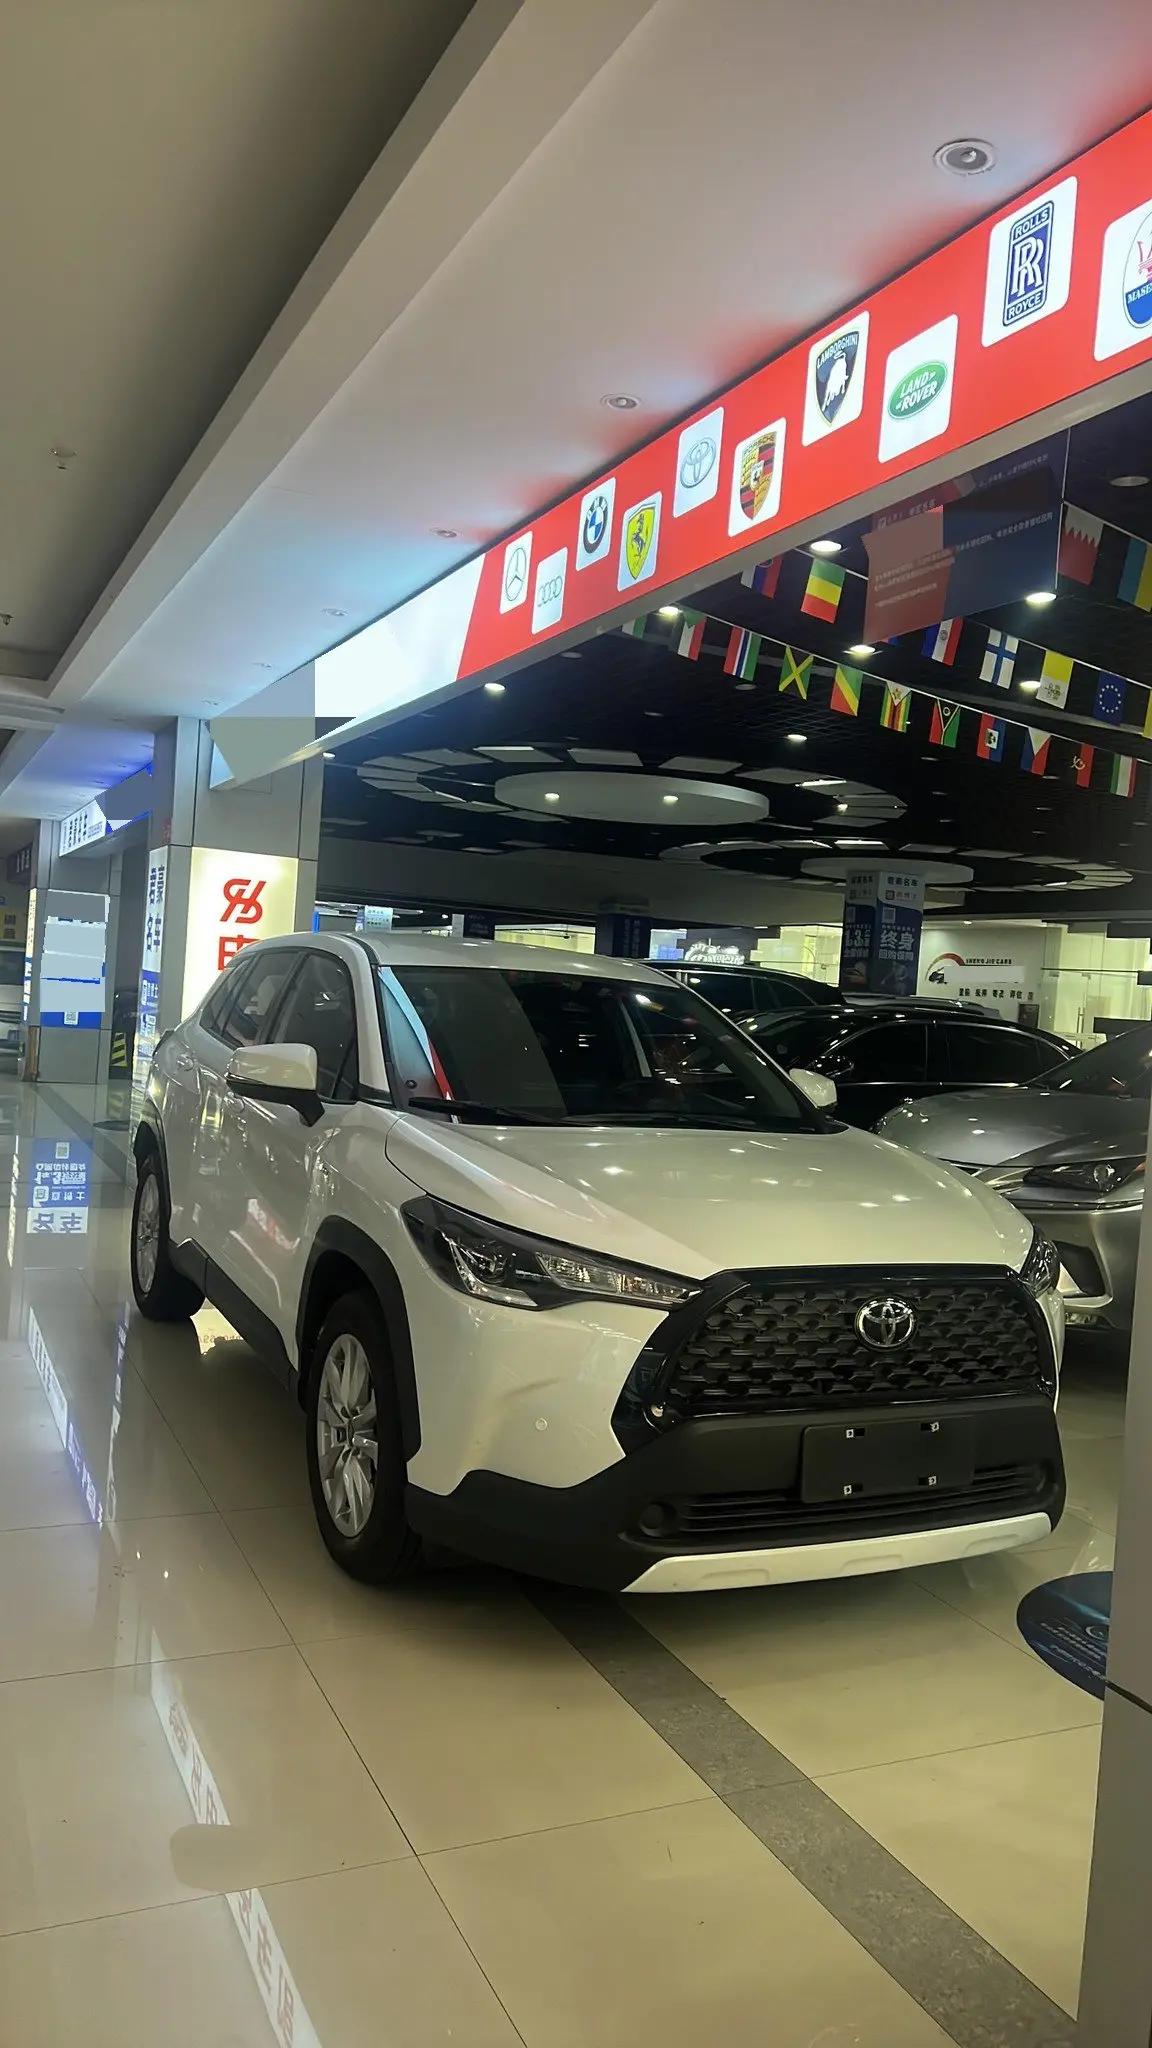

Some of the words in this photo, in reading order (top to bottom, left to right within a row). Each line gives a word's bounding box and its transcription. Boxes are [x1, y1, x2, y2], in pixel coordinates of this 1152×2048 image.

[1013, 208, 1049, 240] ROLLS
[1010, 236, 1045, 299] RR
[1008, 292, 1042, 319] ROYCE
[816, 333, 858, 368] LAMBORGHINI
[900, 371, 929, 399] LAND
[900, 381, 938, 412] ROVER
[880, 930, 915, 950] 终身
